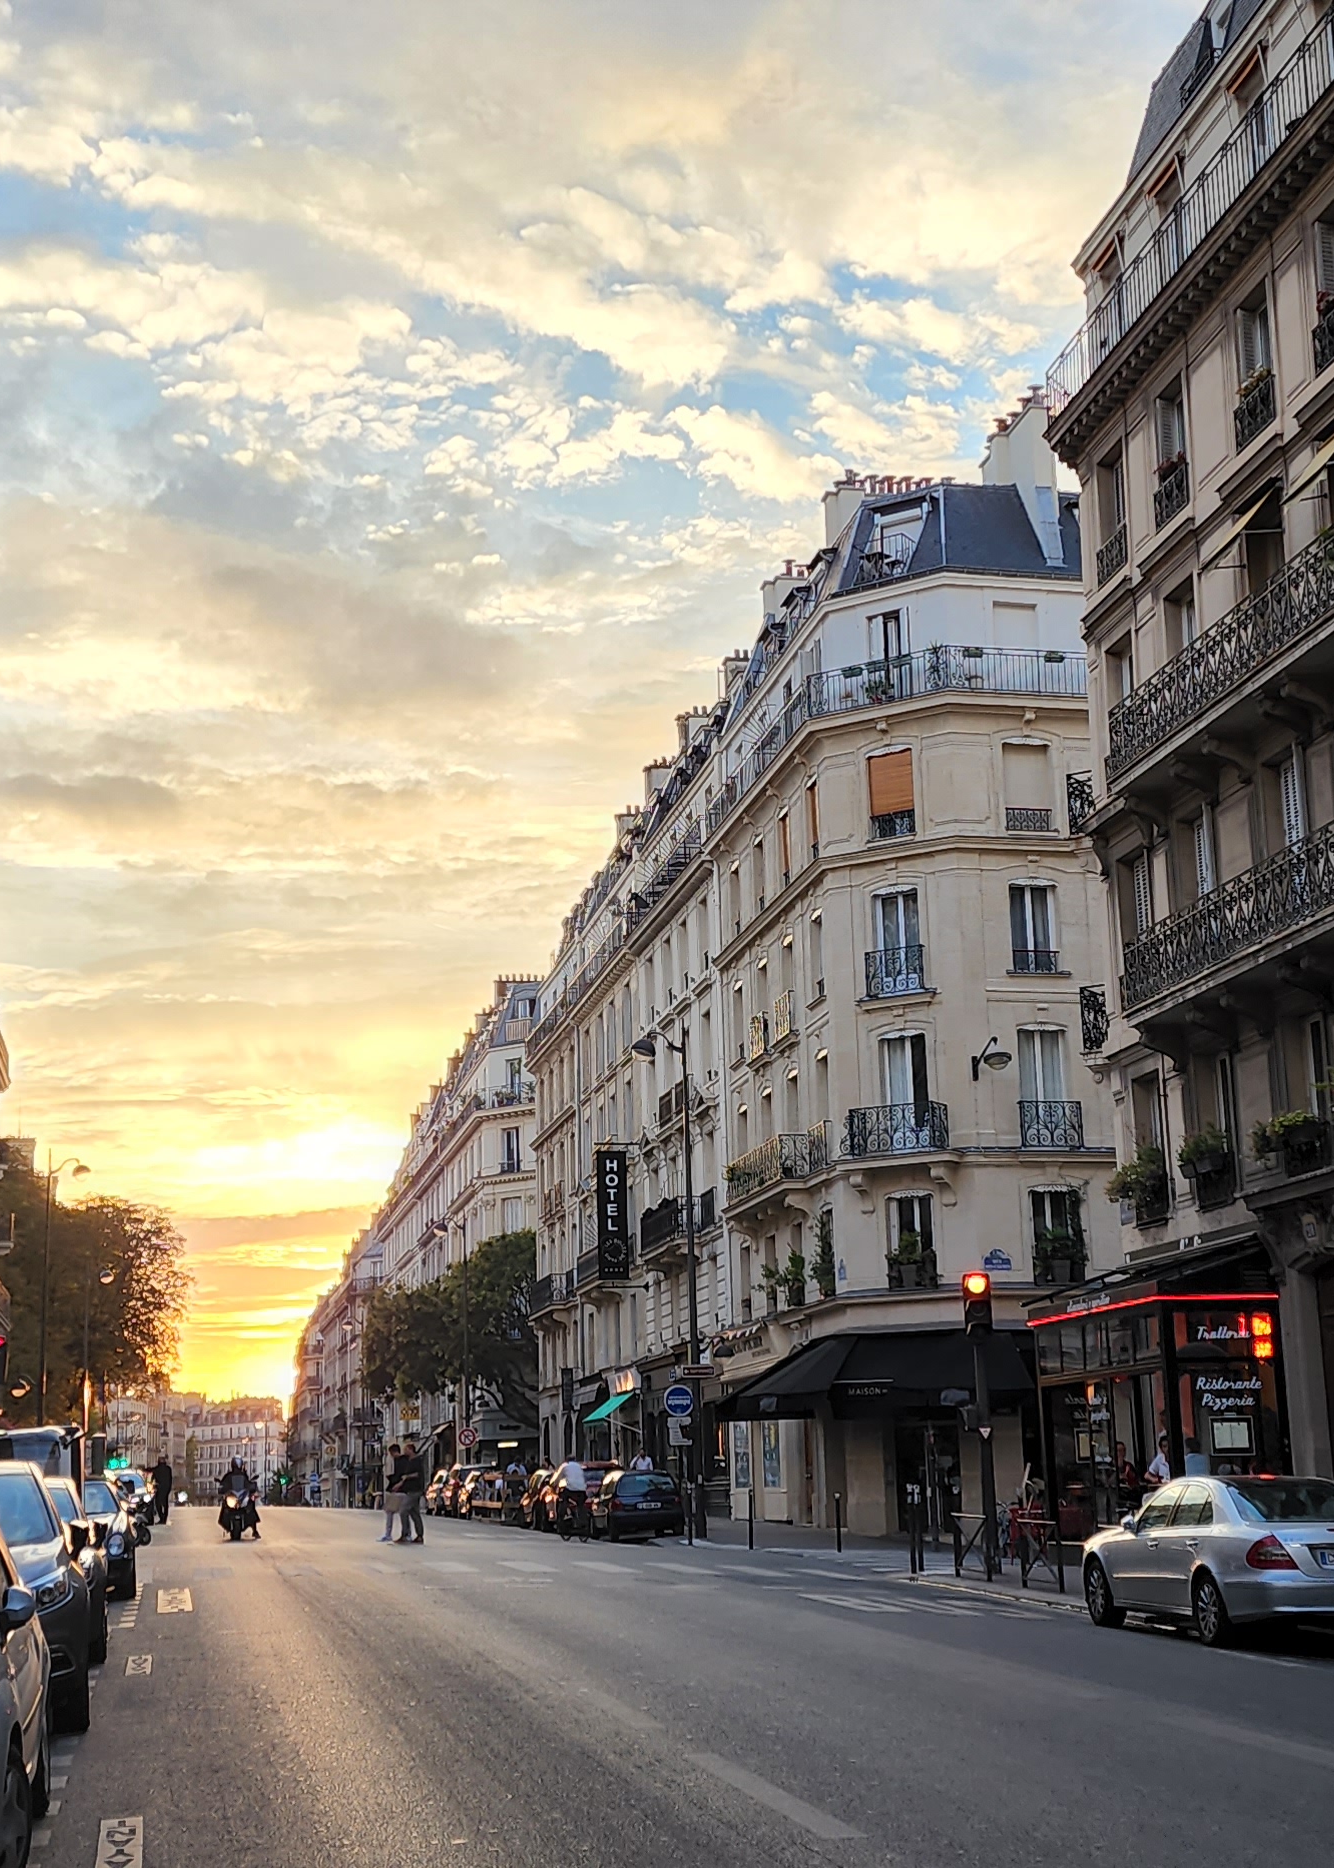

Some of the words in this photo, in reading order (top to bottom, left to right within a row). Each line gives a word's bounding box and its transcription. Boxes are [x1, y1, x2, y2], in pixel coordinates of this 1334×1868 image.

[605, 1159, 619, 1231] HOTEL
[1196, 1376, 1263, 1390] Ristorante
[848, 1387, 881, 1396] MAISON
[1201, 1393, 1255, 1411] Pizzeria
